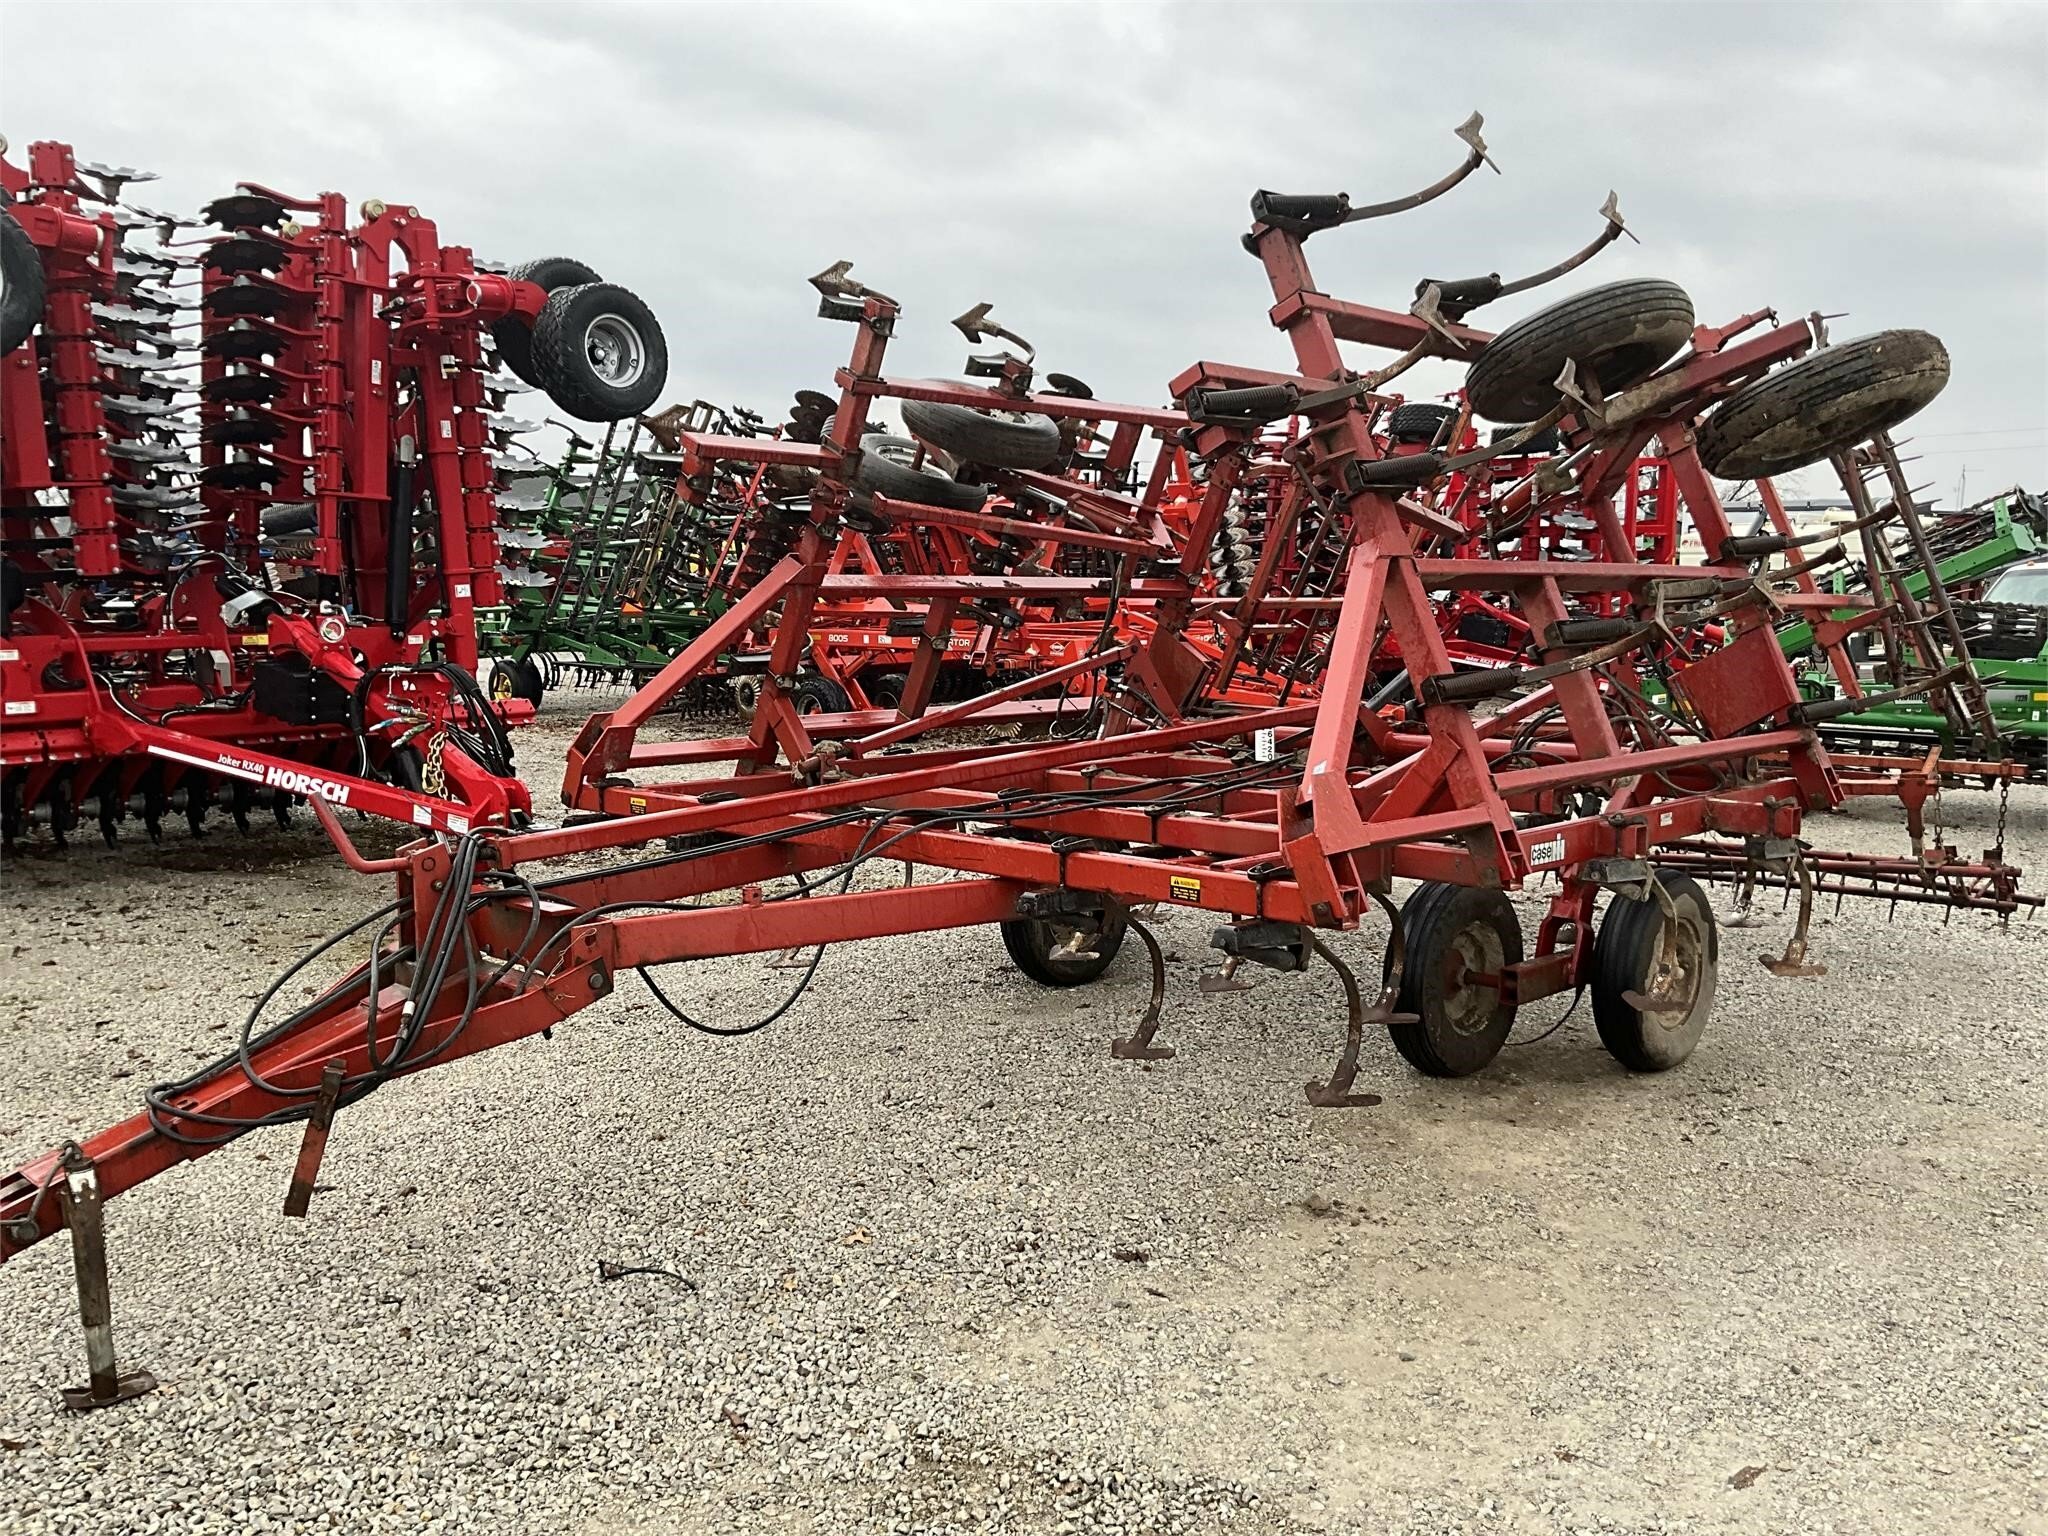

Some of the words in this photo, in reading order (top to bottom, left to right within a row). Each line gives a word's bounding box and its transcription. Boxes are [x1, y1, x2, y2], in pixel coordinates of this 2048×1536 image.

[217, 753, 241, 767] Joker
[242, 759, 265, 774] RX40
[265, 766, 350, 804] HORSCH
